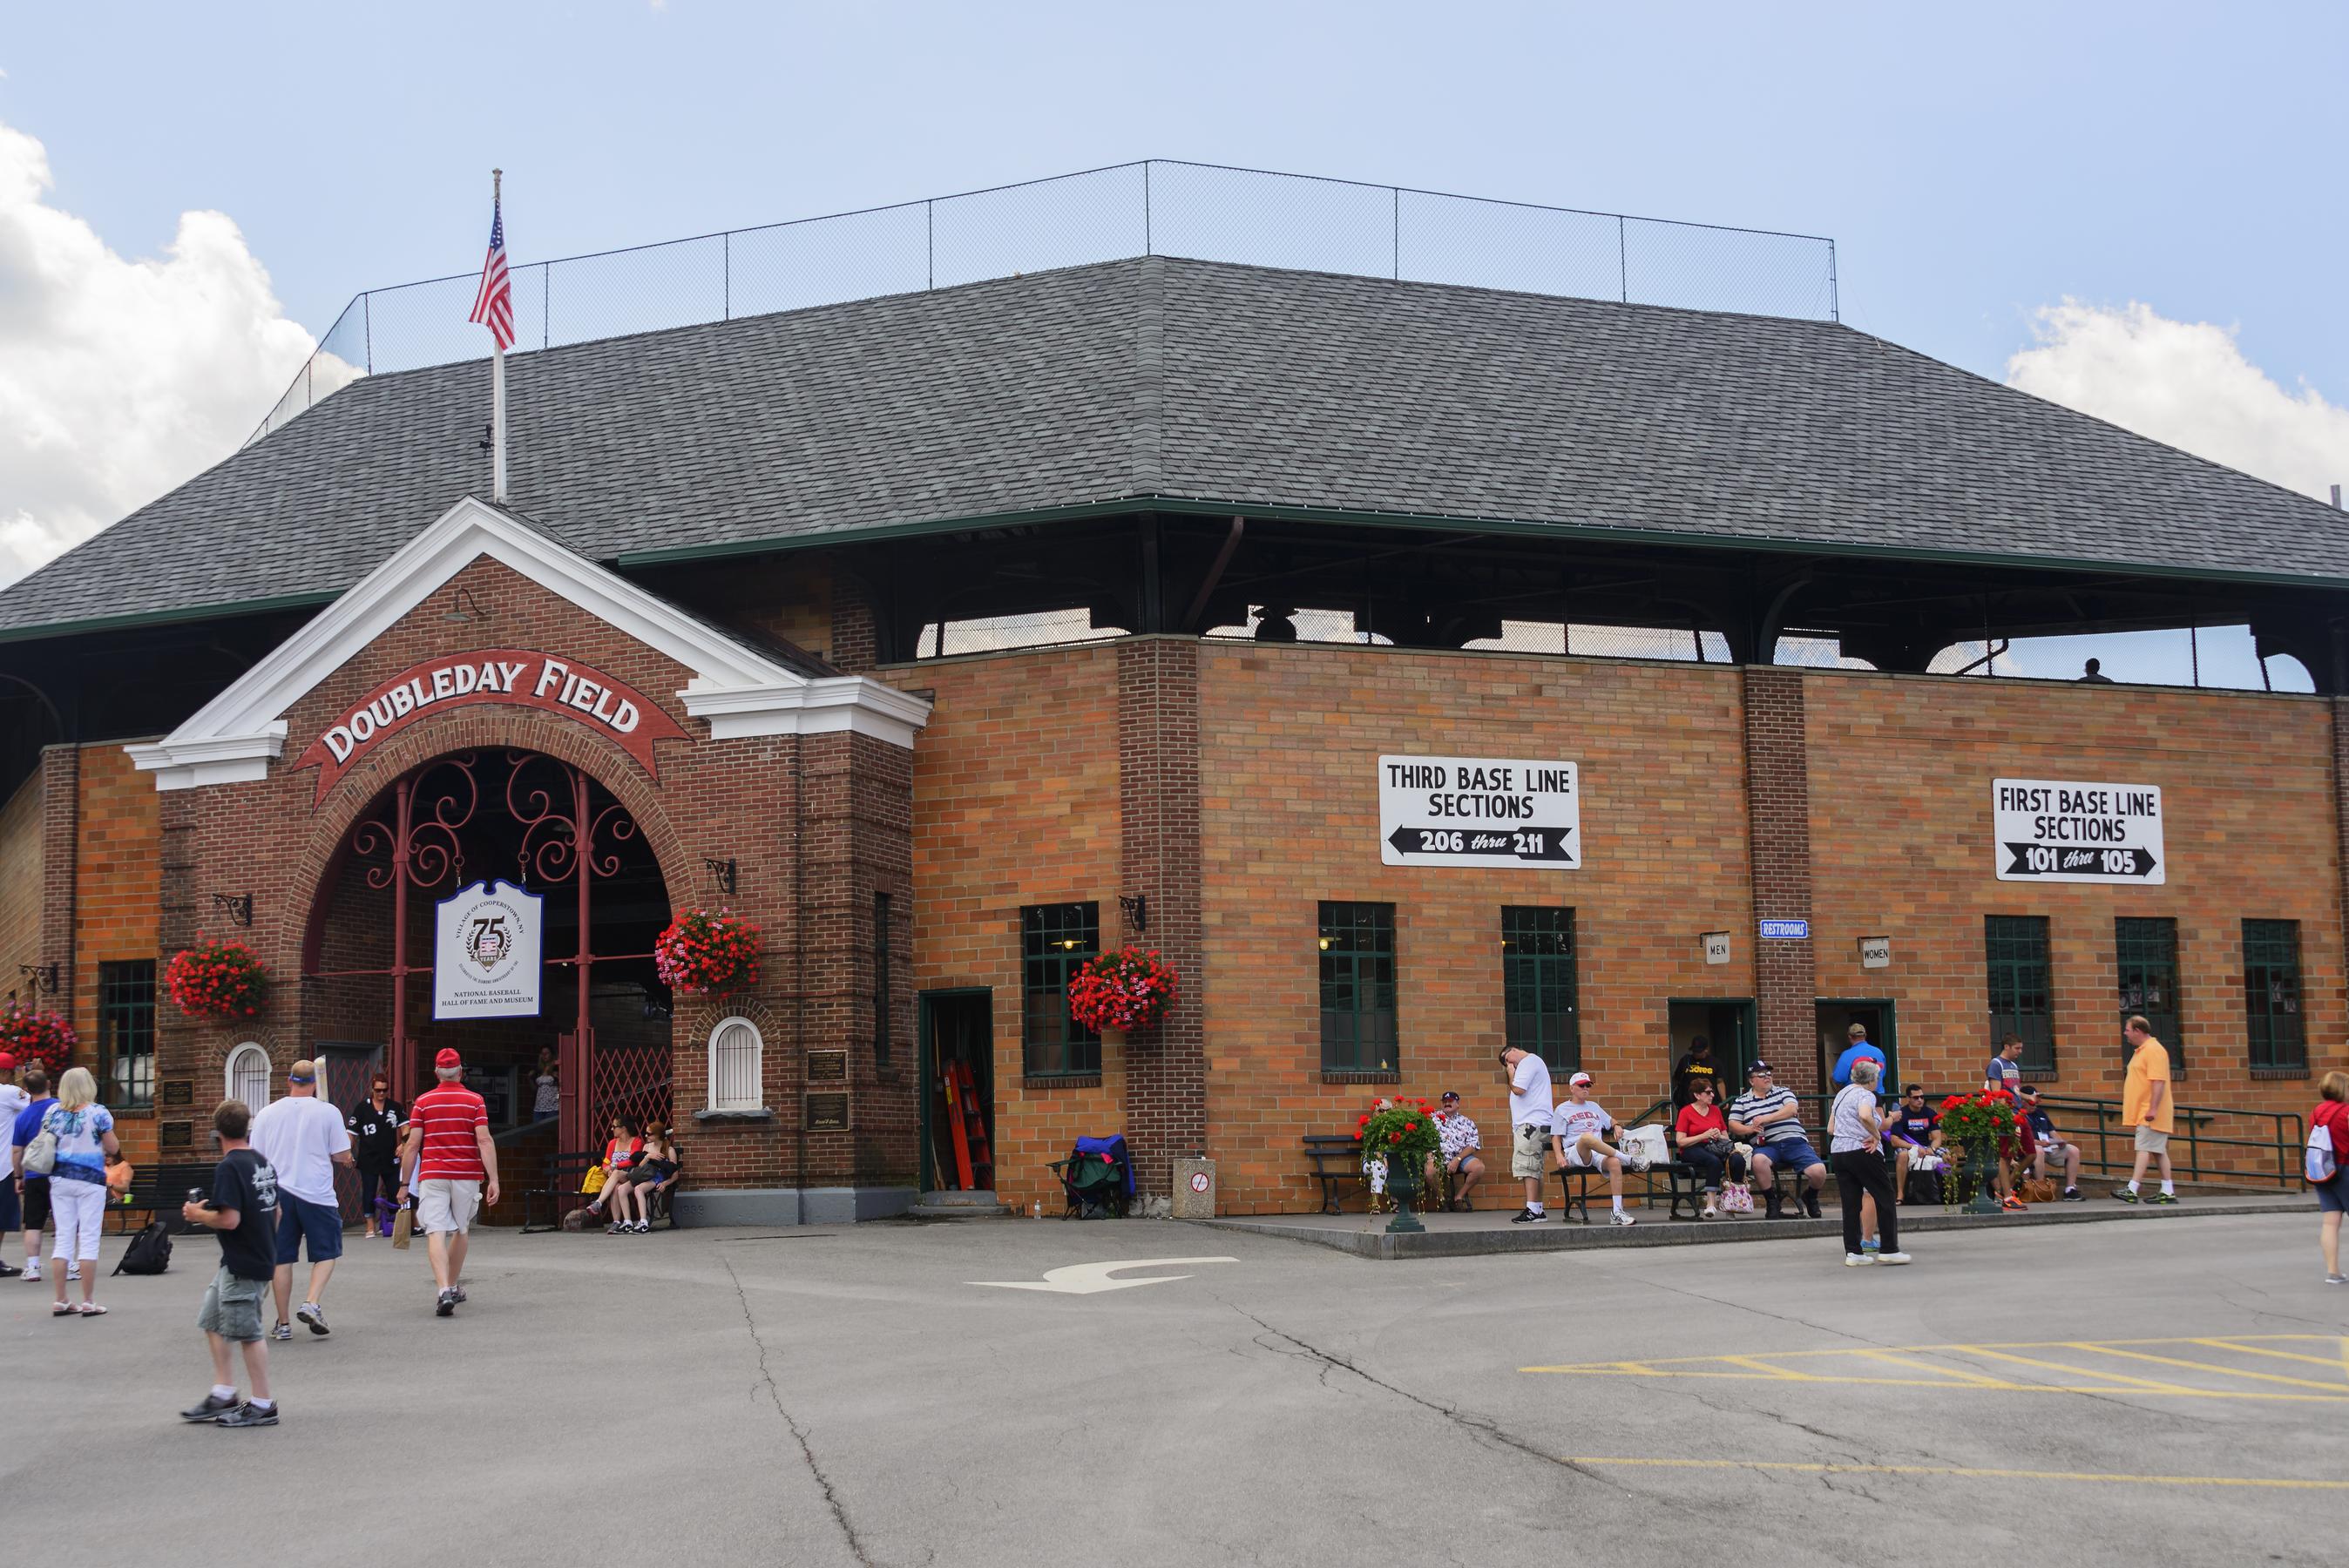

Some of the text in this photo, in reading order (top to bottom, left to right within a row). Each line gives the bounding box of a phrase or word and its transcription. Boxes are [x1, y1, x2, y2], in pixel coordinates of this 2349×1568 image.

[322, 659, 640, 766] DOUBLEDAY FIELD
[1386, 764, 1570, 794] THIRD BASE LINE
[1427, 793, 1534, 819] SECTIONS
[2000, 787, 2156, 817] FIRST BASE LINE
[2033, 815, 2126, 842] SECTIONS
[1419, 831, 1544, 854] 206 thru 211
[2025, 847, 2136, 874] 101 thru 105
[456, 910, 471, 939] VILLAGE
[473, 916, 505, 950] 75
[1763, 923, 1805, 936] RESTROOMS
[1709, 944, 1727, 956] MEN
[1864, 949, 1889, 960] WOMEN
[362, 1123, 376, 1136] 13
